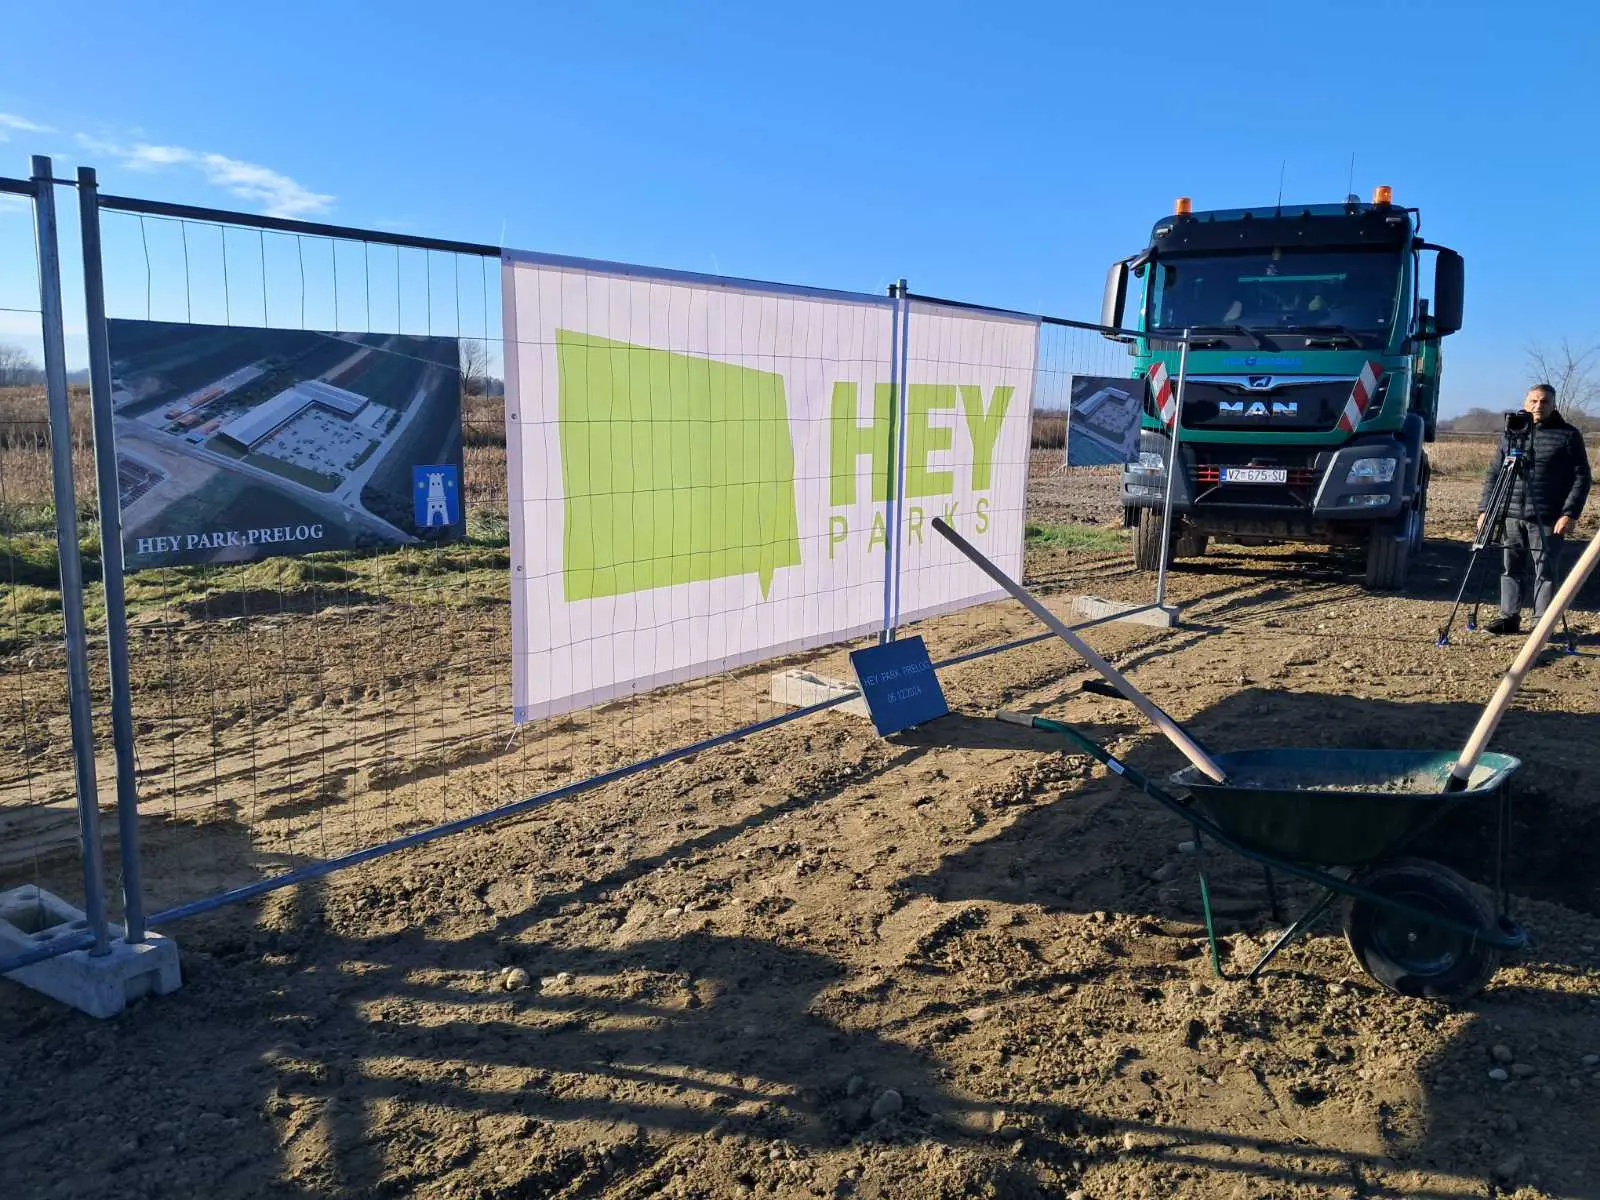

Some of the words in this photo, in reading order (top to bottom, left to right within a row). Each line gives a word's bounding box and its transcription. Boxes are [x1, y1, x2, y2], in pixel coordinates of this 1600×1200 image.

[1219, 401, 1298, 416] MAN
[830, 381, 1016, 507] HEY
[136, 535, 182, 554] HEY
[248, 524, 324, 545] PRELOG
[828, 497, 990, 560] PARKS
[864, 673, 879, 688] HEY
[880, 670, 899, 682] PARK
[902, 660, 931, 676] PRELOG
